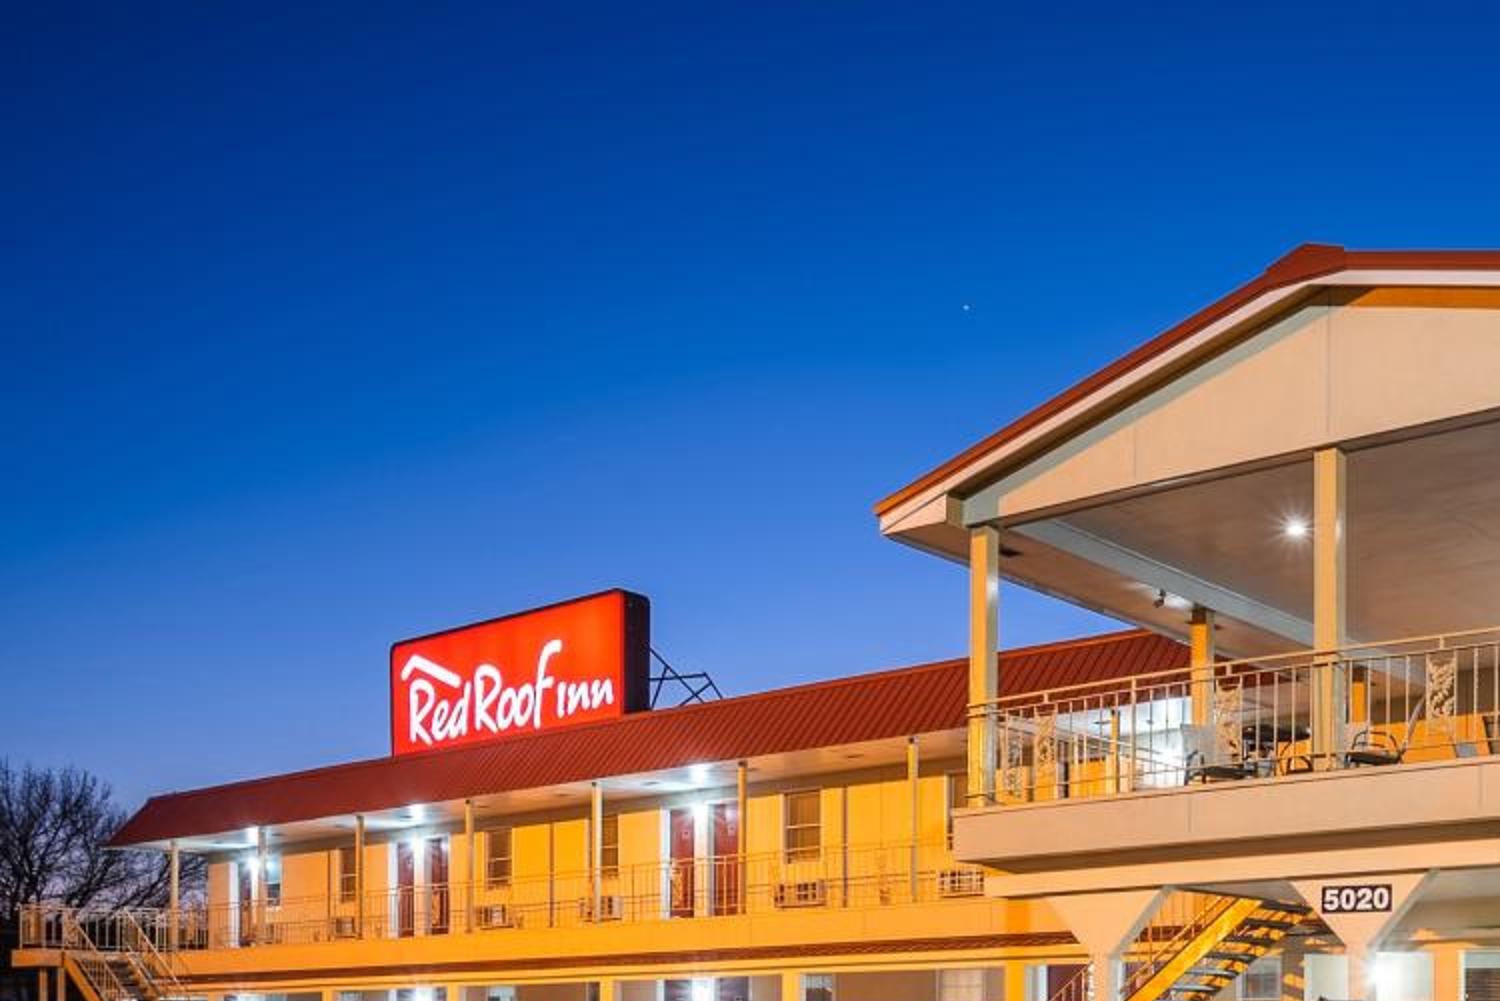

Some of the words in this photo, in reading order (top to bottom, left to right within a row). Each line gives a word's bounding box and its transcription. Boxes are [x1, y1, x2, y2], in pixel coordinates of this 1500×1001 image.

[409, 679, 471, 744] Red
[474, 638, 563, 733] Roof
[1323, 887, 1389, 911] 5020
